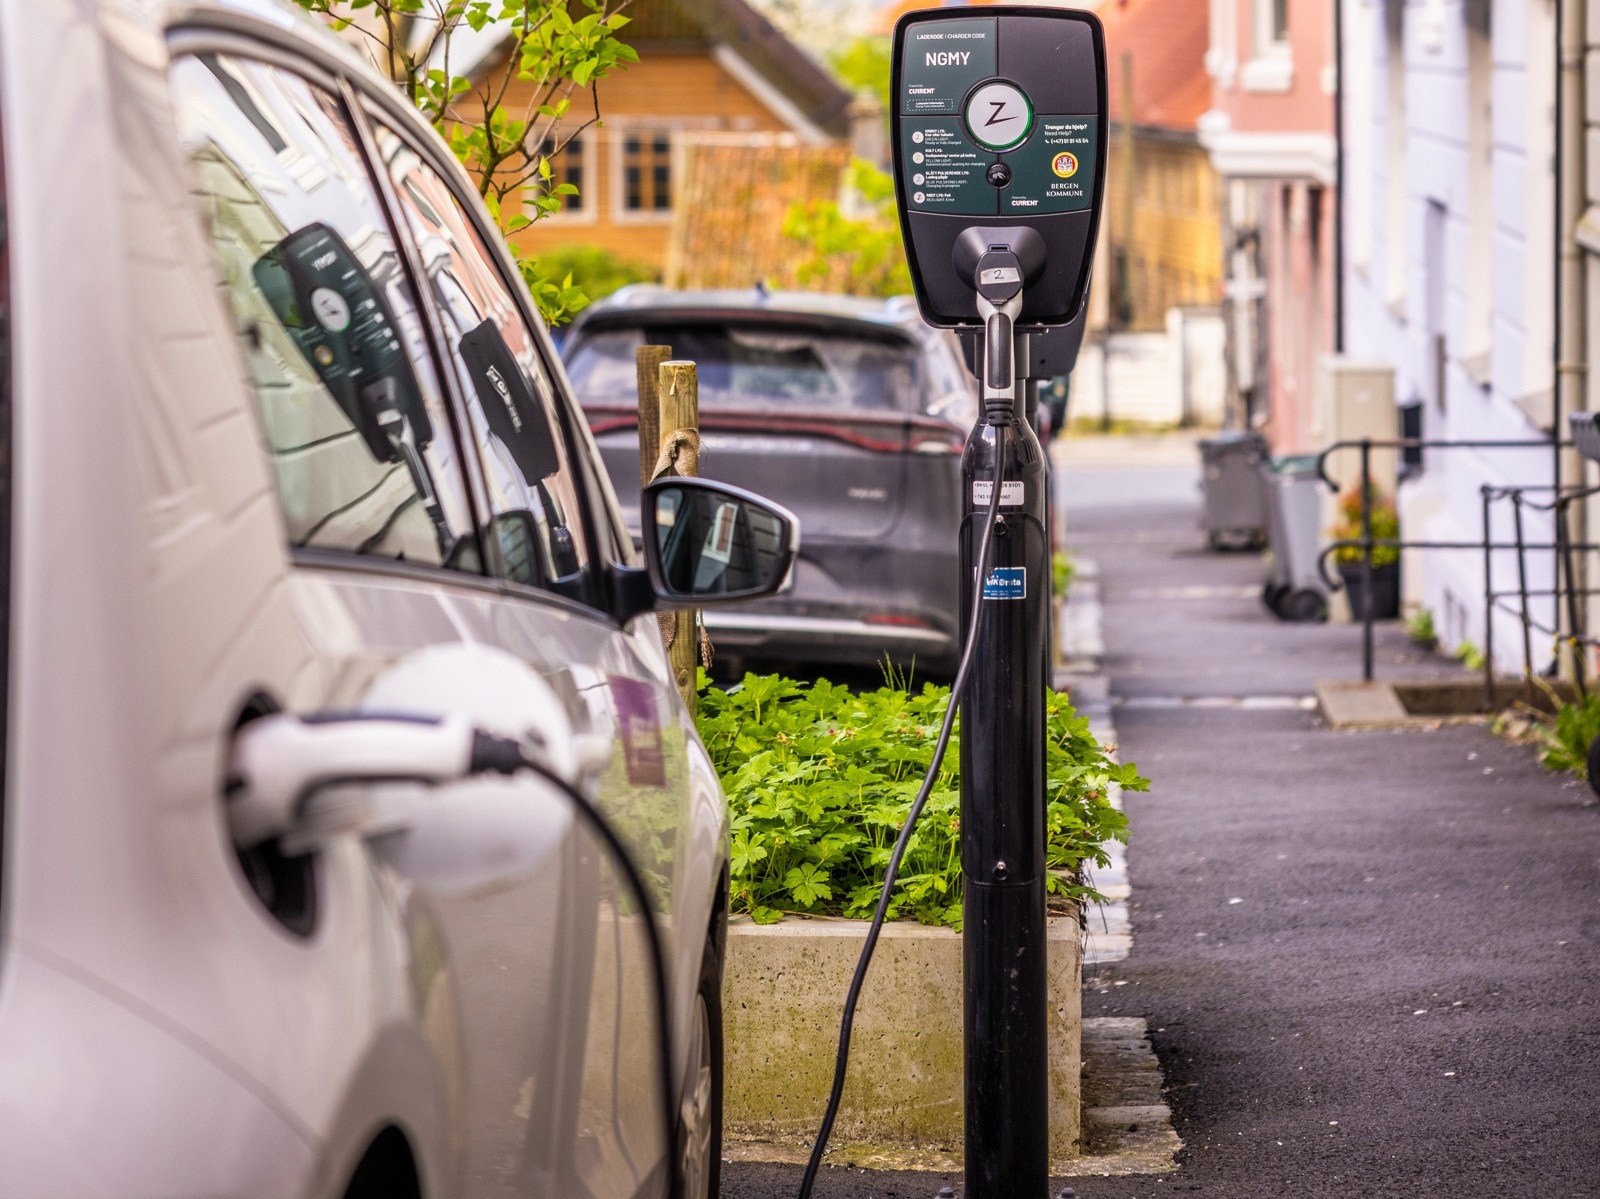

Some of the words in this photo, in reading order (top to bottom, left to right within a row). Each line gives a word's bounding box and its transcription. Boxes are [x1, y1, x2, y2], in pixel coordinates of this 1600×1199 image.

[926, 52, 970, 66] NGMY
[1072, 123, 1088, 131] hjelp?
[1046, 190, 1084, 198] KOMMUNE
[993, 269, 1005, 280] 2
